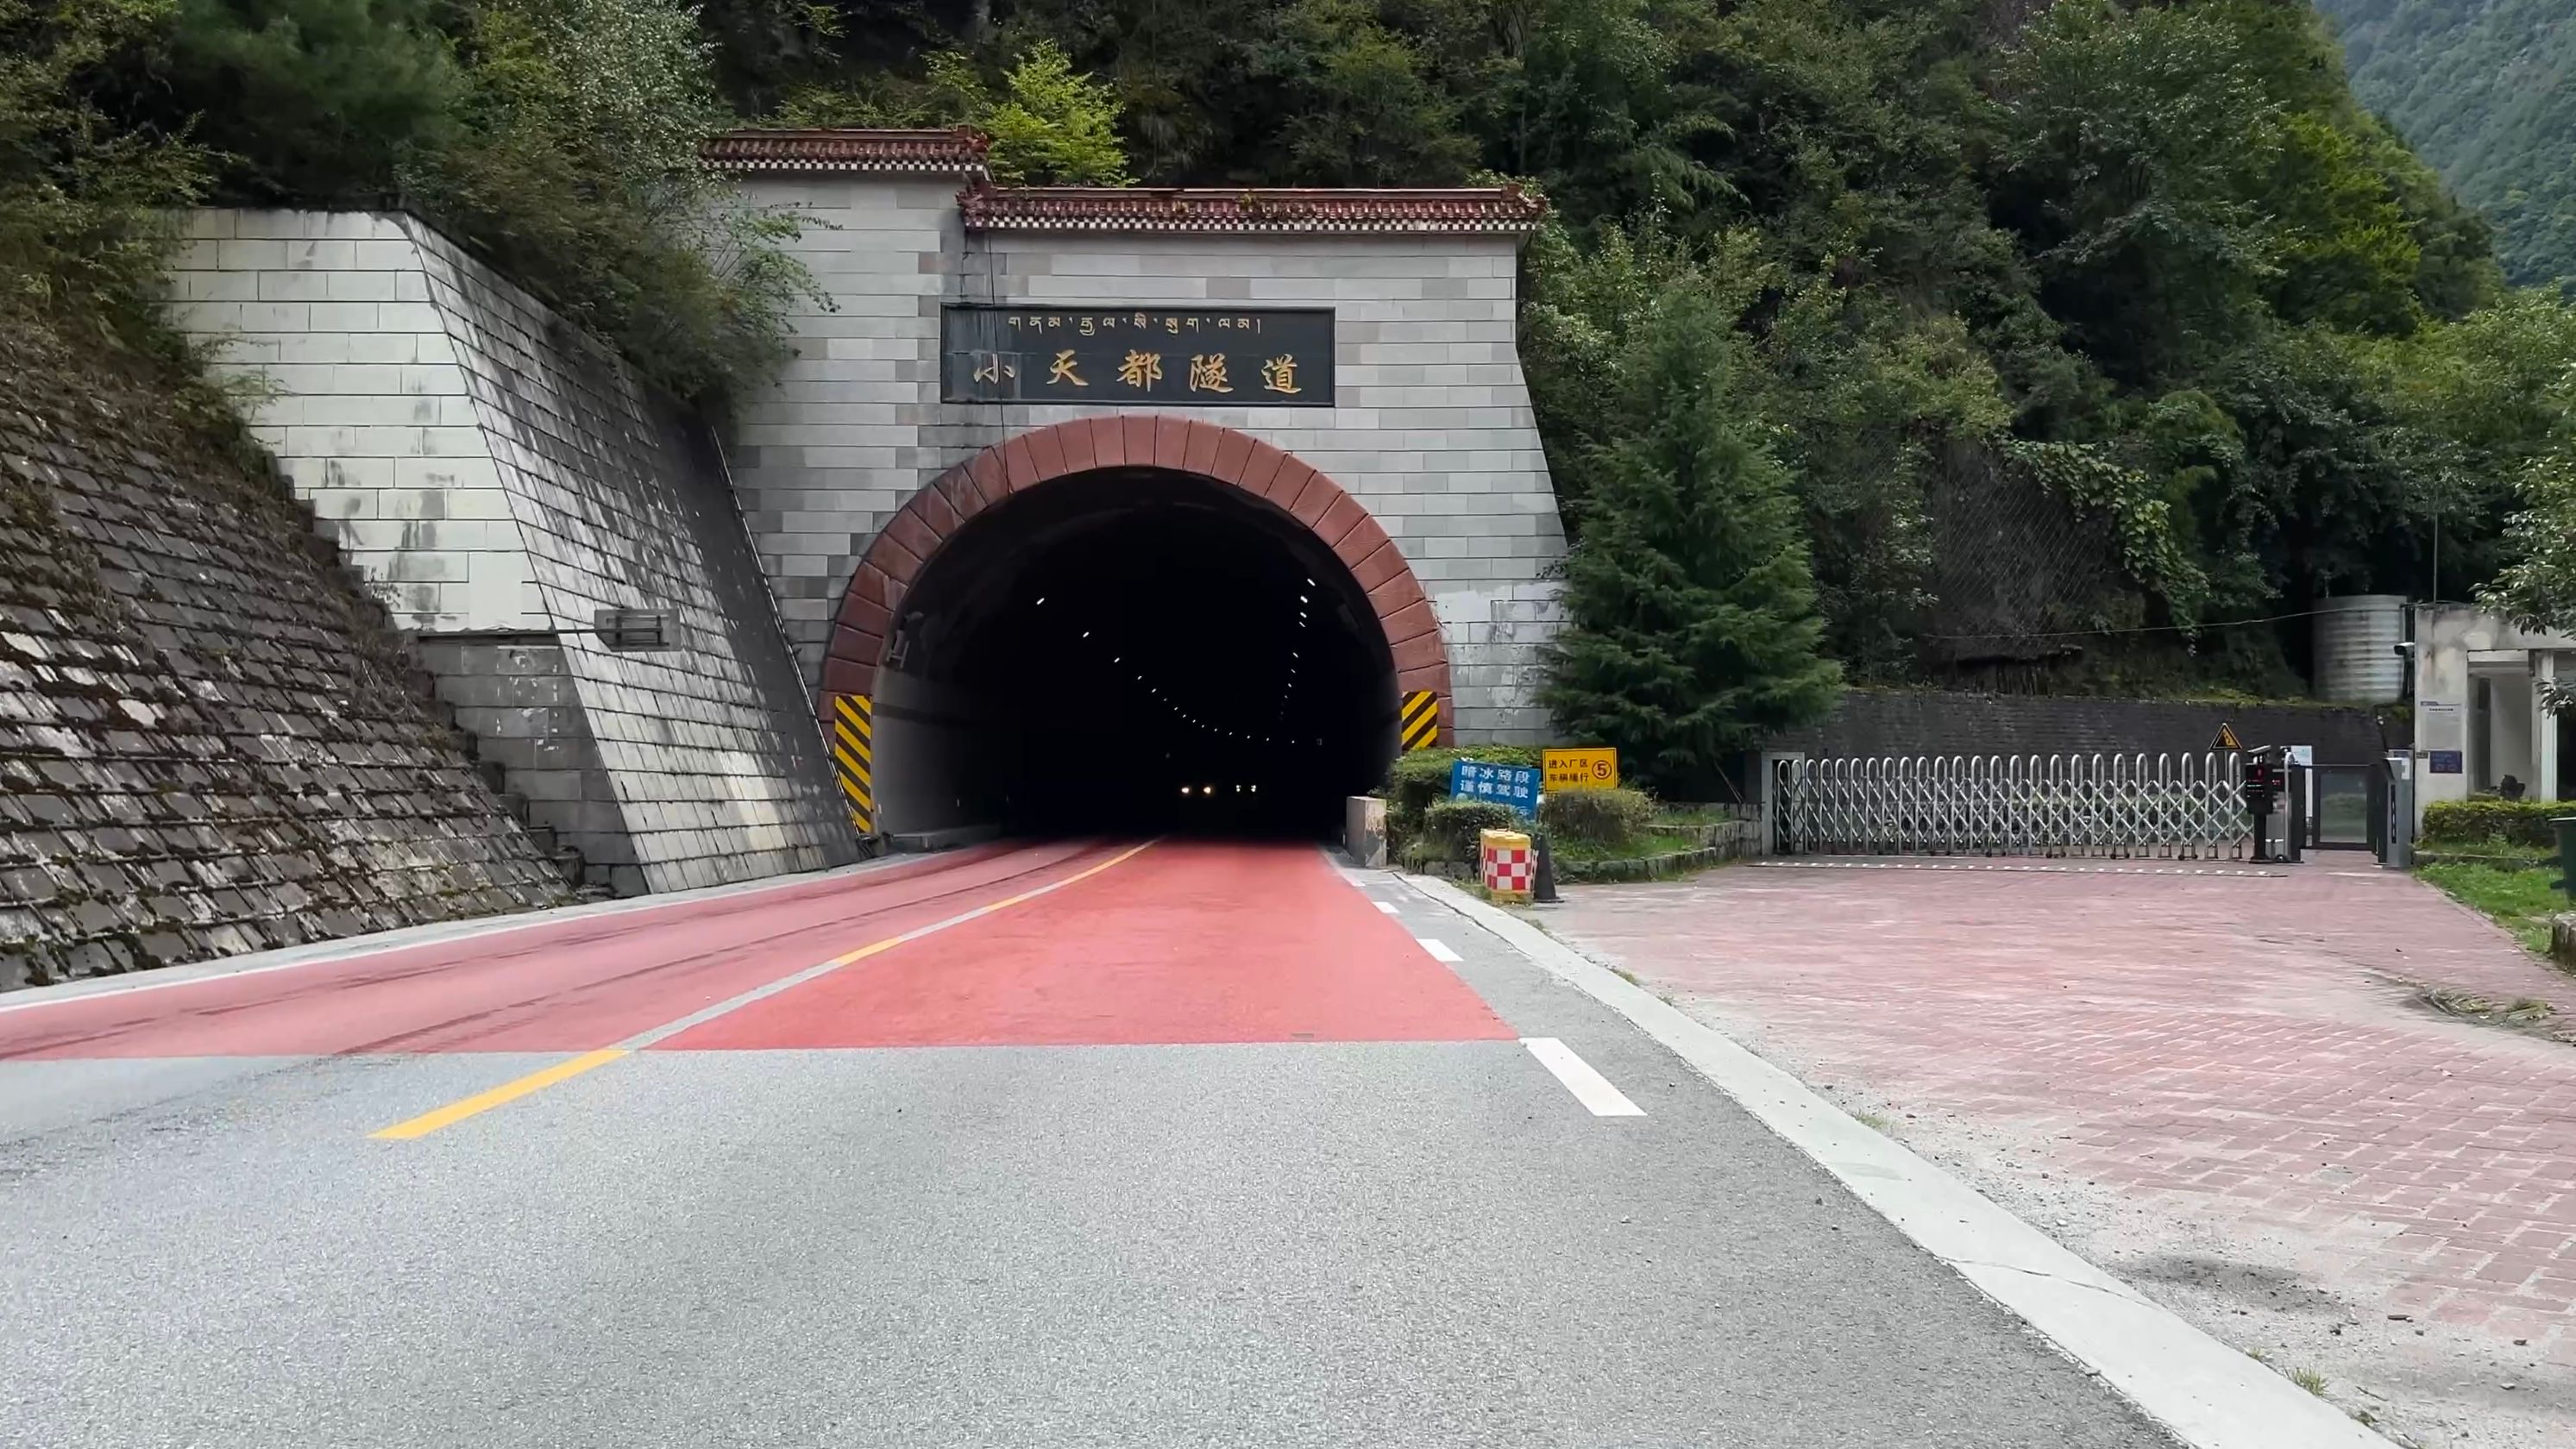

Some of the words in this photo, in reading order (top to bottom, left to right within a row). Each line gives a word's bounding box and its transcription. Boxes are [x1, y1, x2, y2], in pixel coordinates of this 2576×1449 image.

[973, 348, 1302, 394] 小天都隧道
[1549, 758, 1588, 768] 进入厂区
[1461, 764, 1530, 784] 暗冰路段
[1460, 779, 1529, 799] 谨慎驾驶
